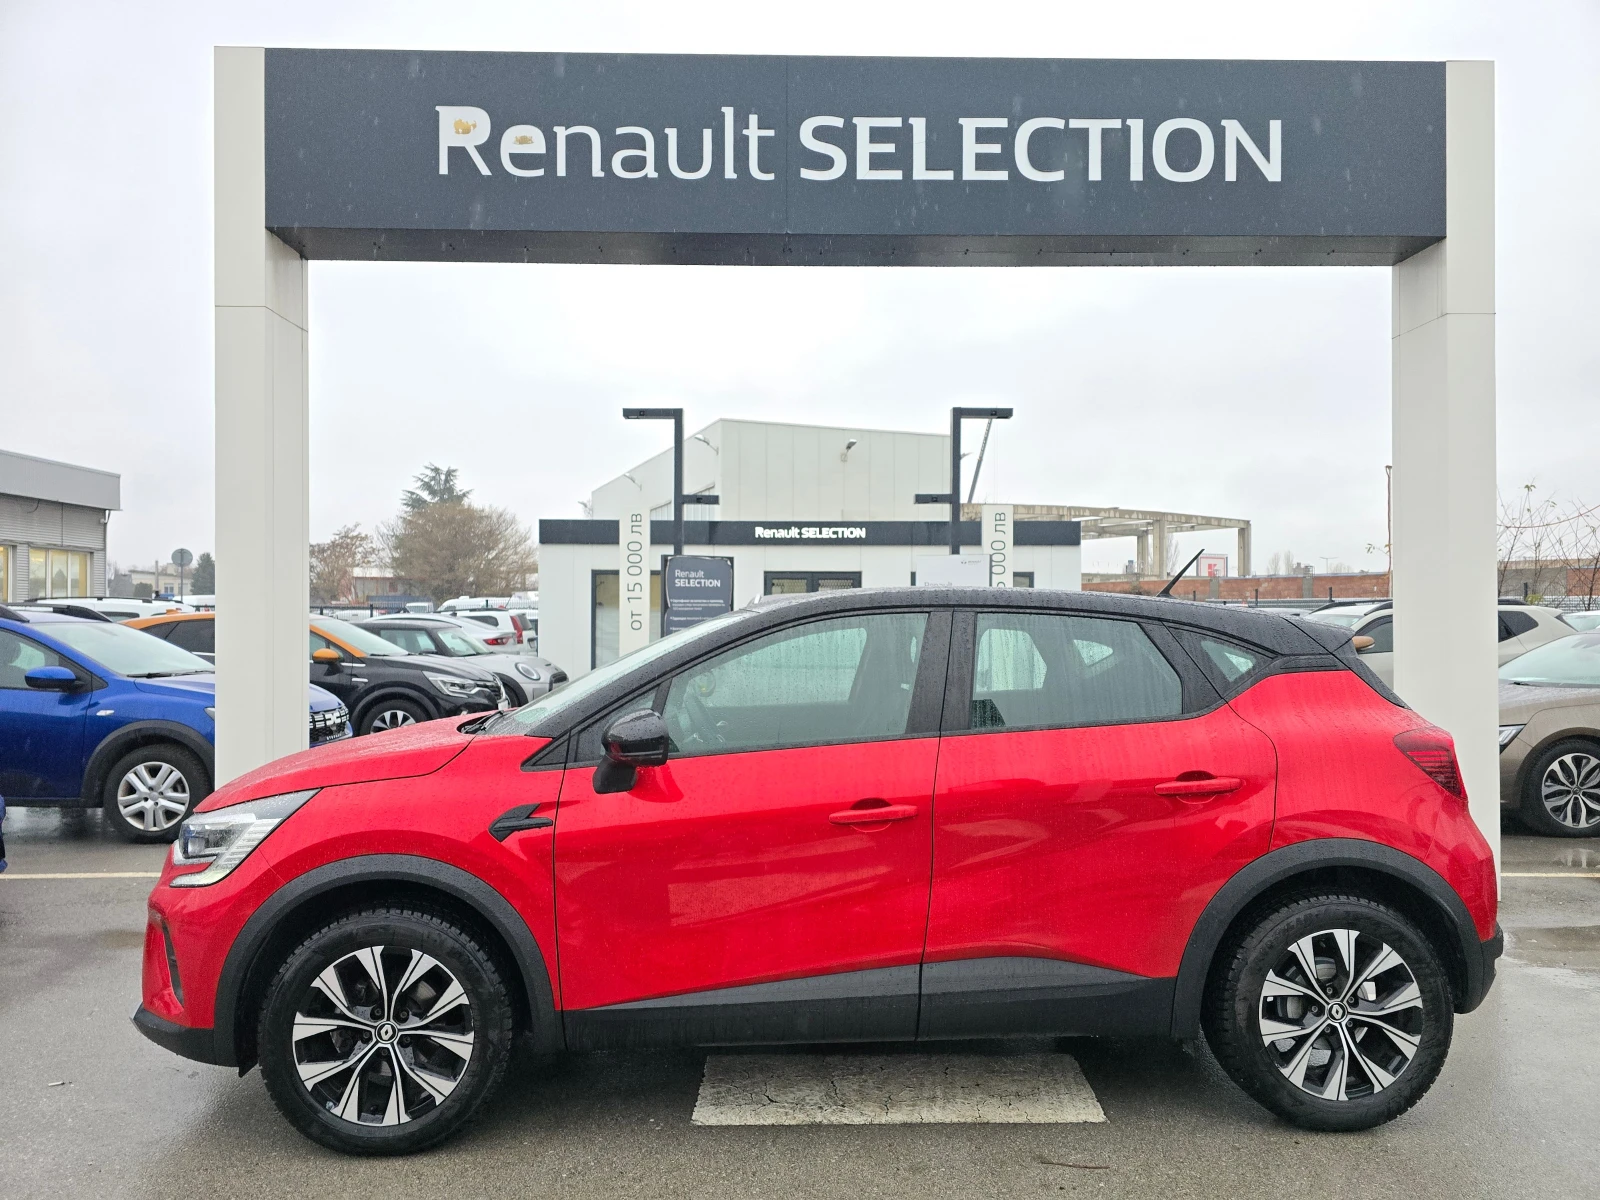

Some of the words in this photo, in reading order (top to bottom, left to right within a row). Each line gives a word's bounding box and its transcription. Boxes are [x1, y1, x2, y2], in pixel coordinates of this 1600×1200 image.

[435, 105, 776, 182] Renault
[800, 115, 1282, 184] SELECTION
[754, 526, 800, 539] Renault
[801, 527, 866, 539] SELECTION
[627, 540, 643, 577] 000
[674, 569, 705, 579] Renault
[674, 578, 721, 588] SELECTION
[627, 582, 643, 604] 15
